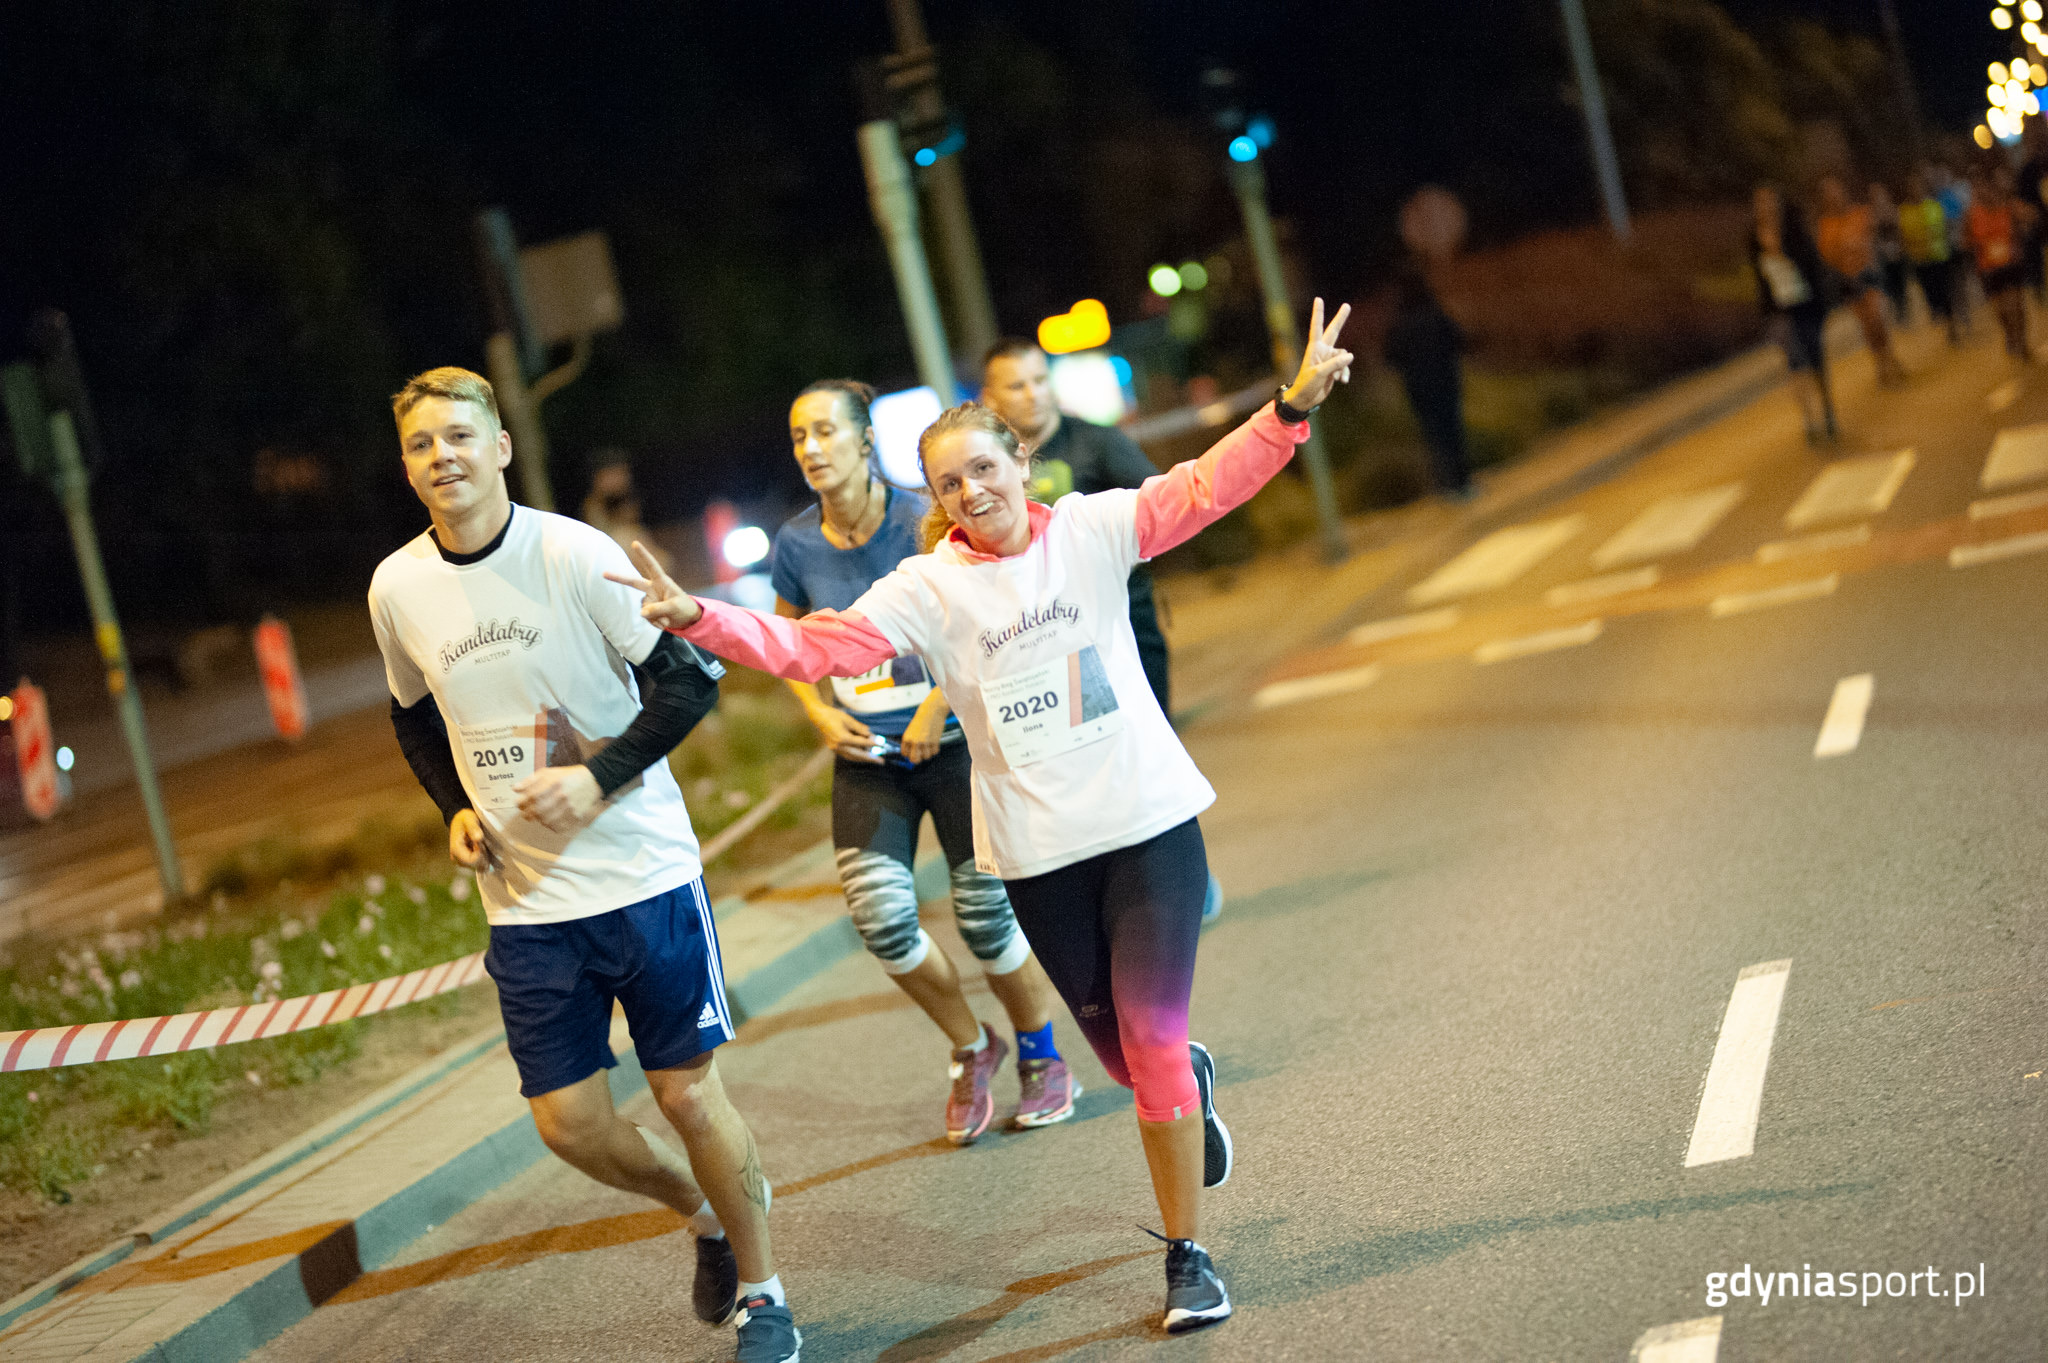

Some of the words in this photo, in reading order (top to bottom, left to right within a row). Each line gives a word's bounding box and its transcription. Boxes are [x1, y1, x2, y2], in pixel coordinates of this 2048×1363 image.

[979, 597, 1080, 658] Kandelabry
[439, 618, 541, 673] Kandelabry
[474, 649, 511, 665] MULTITAP
[999, 691, 1059, 723] 2020
[473, 745, 524, 768] 2019
[488, 772, 514, 781] Bartosz
[697, 1017, 720, 1029] adidas
